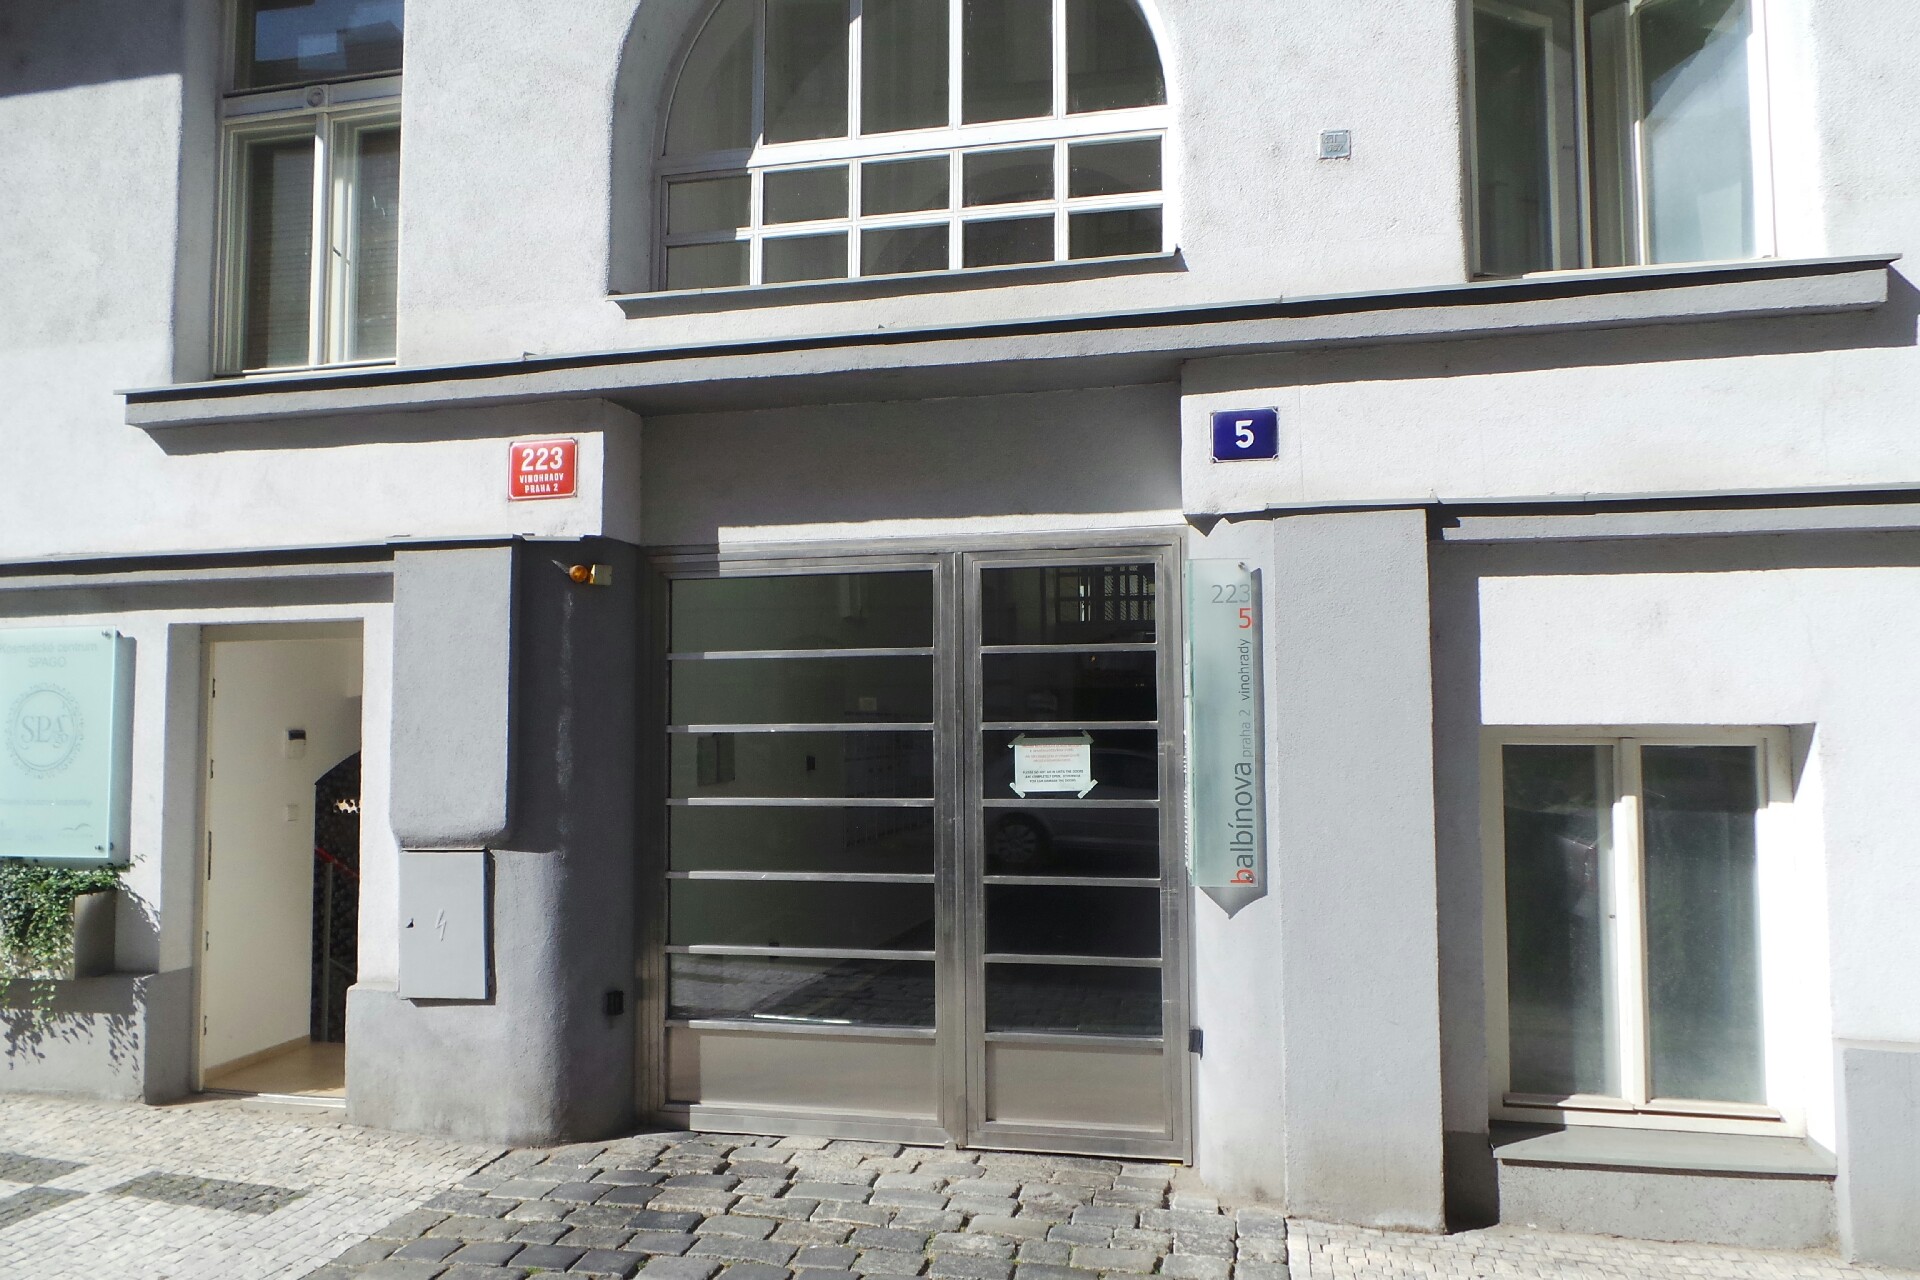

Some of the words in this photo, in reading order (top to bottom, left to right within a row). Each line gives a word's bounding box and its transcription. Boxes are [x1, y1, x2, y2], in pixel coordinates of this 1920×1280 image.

[1235, 419, 1255, 449] 5
[521, 446, 563, 471] 223
[519, 472, 564, 484] VINOHRADY
[524, 484, 551, 494] PRAHA
[553, 483, 559, 492] 2
[1211, 583, 1251, 604] 223
[1238, 607, 1253, 629] 5
[28, 656, 67, 669] SPAGO
[1237, 638, 1252, 701] vinohrady
[1238, 709, 1251, 717] 2
[1239, 722, 1254, 757] praha
[1227, 762, 1255, 884] balbínova
